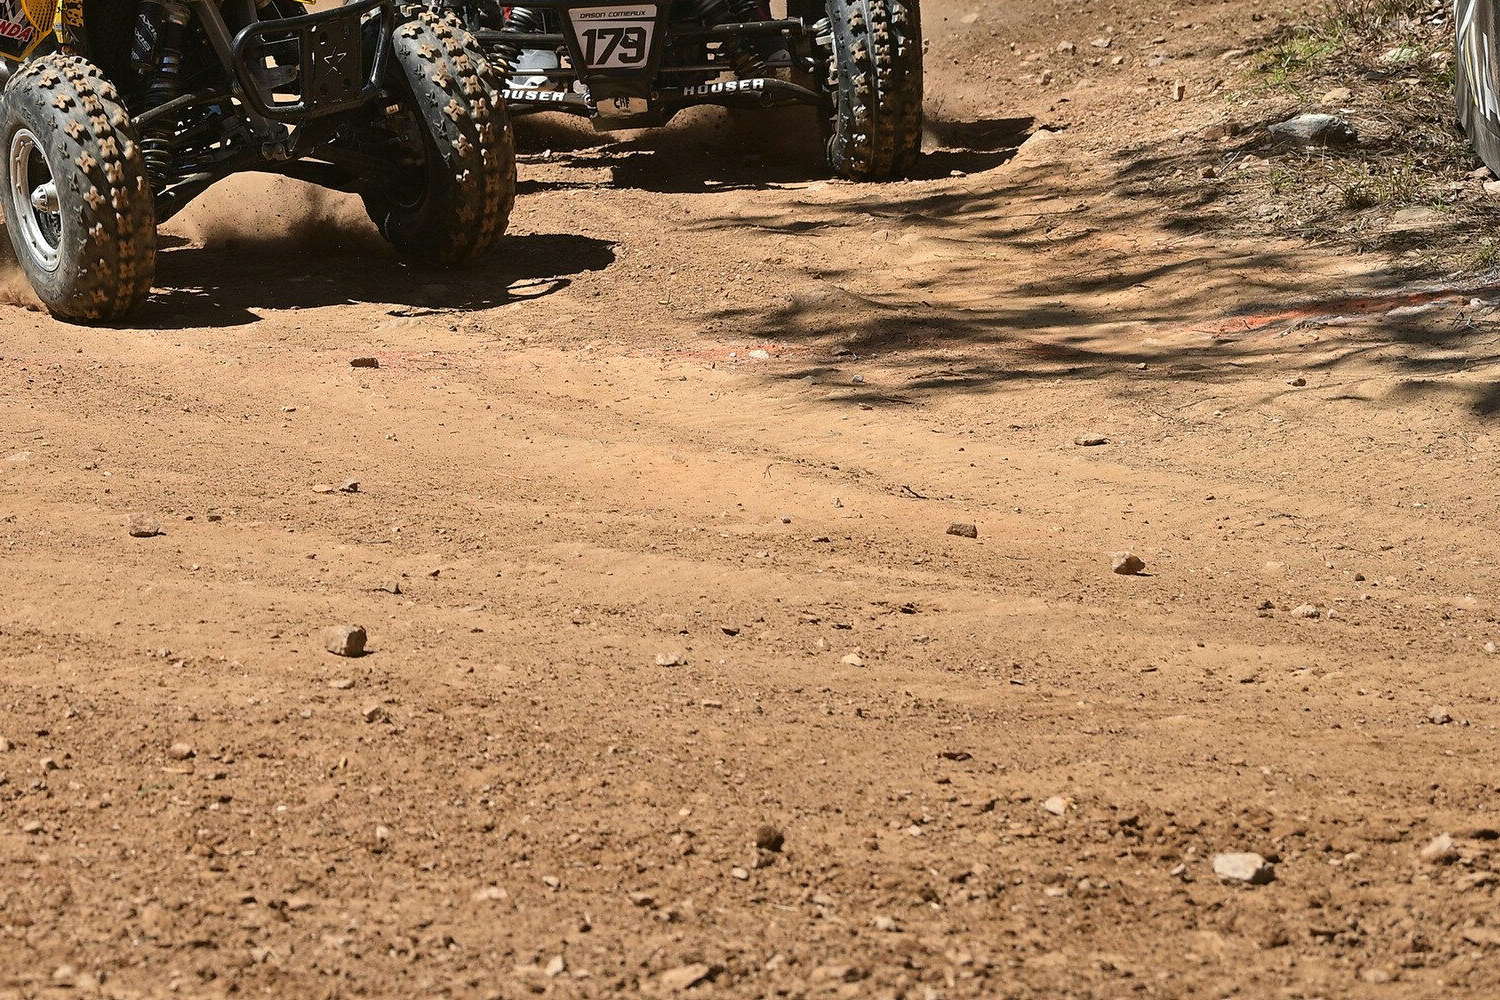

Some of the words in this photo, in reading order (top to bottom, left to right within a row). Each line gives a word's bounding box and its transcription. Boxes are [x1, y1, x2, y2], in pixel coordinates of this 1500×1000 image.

[580, 11, 606, 19] DASON
[608, 10, 646, 18] COMEAUX
[581, 26, 647, 66] 179
[684, 78, 765, 96] HOUSER
